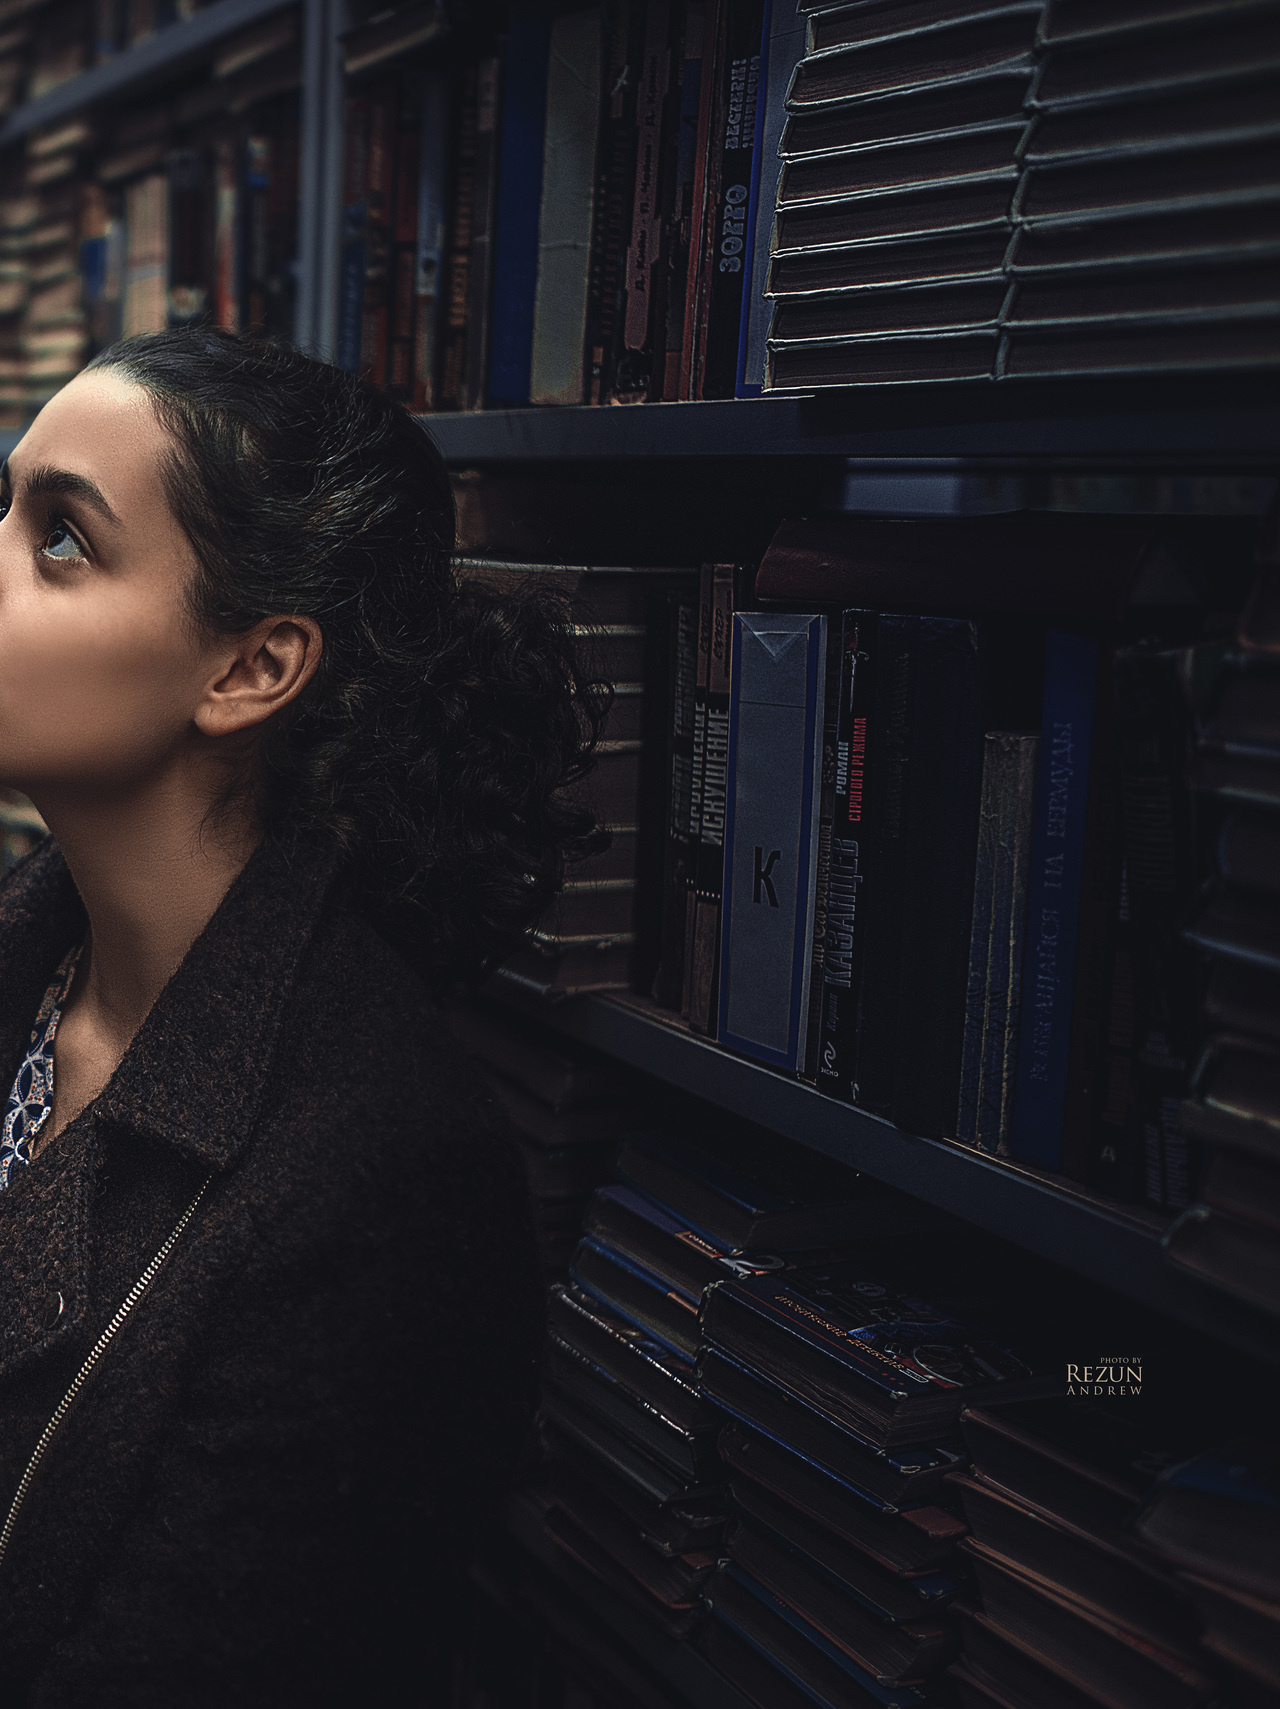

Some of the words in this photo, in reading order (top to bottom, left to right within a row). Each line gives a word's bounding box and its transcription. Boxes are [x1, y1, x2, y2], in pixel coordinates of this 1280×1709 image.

[724, 58, 748, 150] ВЕСТЕРН!
[719, 184, 748, 273] ЗОРРО
[700, 708, 729, 847] ИСКУШЕНИЕ
[835, 741, 849, 796] РОМАН
[851, 716, 867, 766] РЕЖИМА
[848, 769, 862, 822] СТРОГОГО
[824, 838, 861, 988] КАЗАНЦЕВ
